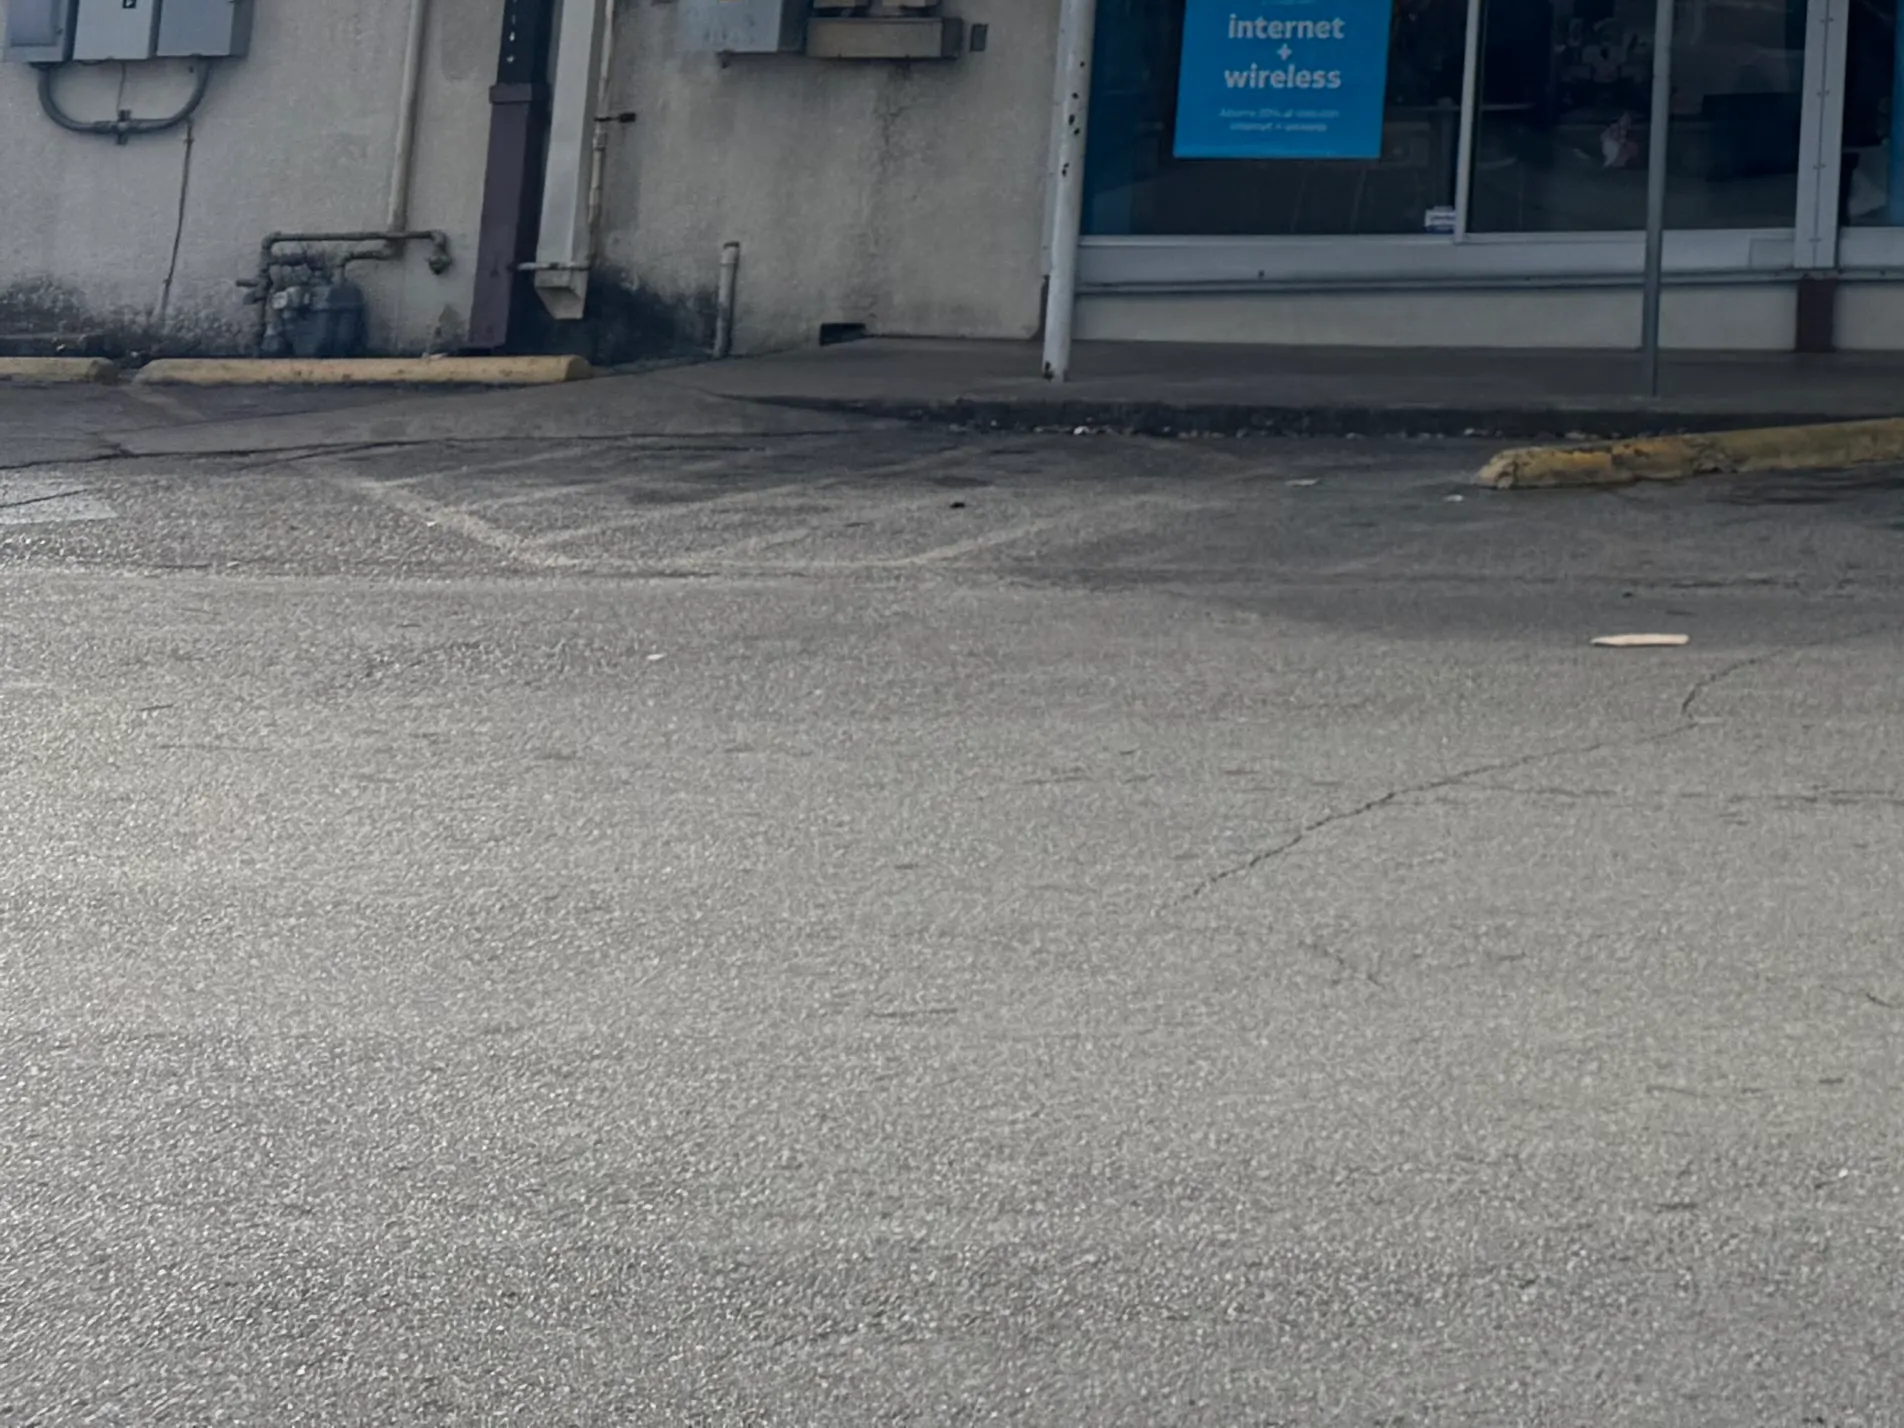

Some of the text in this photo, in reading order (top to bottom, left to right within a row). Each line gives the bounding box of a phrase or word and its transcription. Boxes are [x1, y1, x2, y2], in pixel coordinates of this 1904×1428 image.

[1227, 13, 1346, 40] internet
[1276, 42, 1293, 61] +
[1223, 62, 1343, 90] wireless
